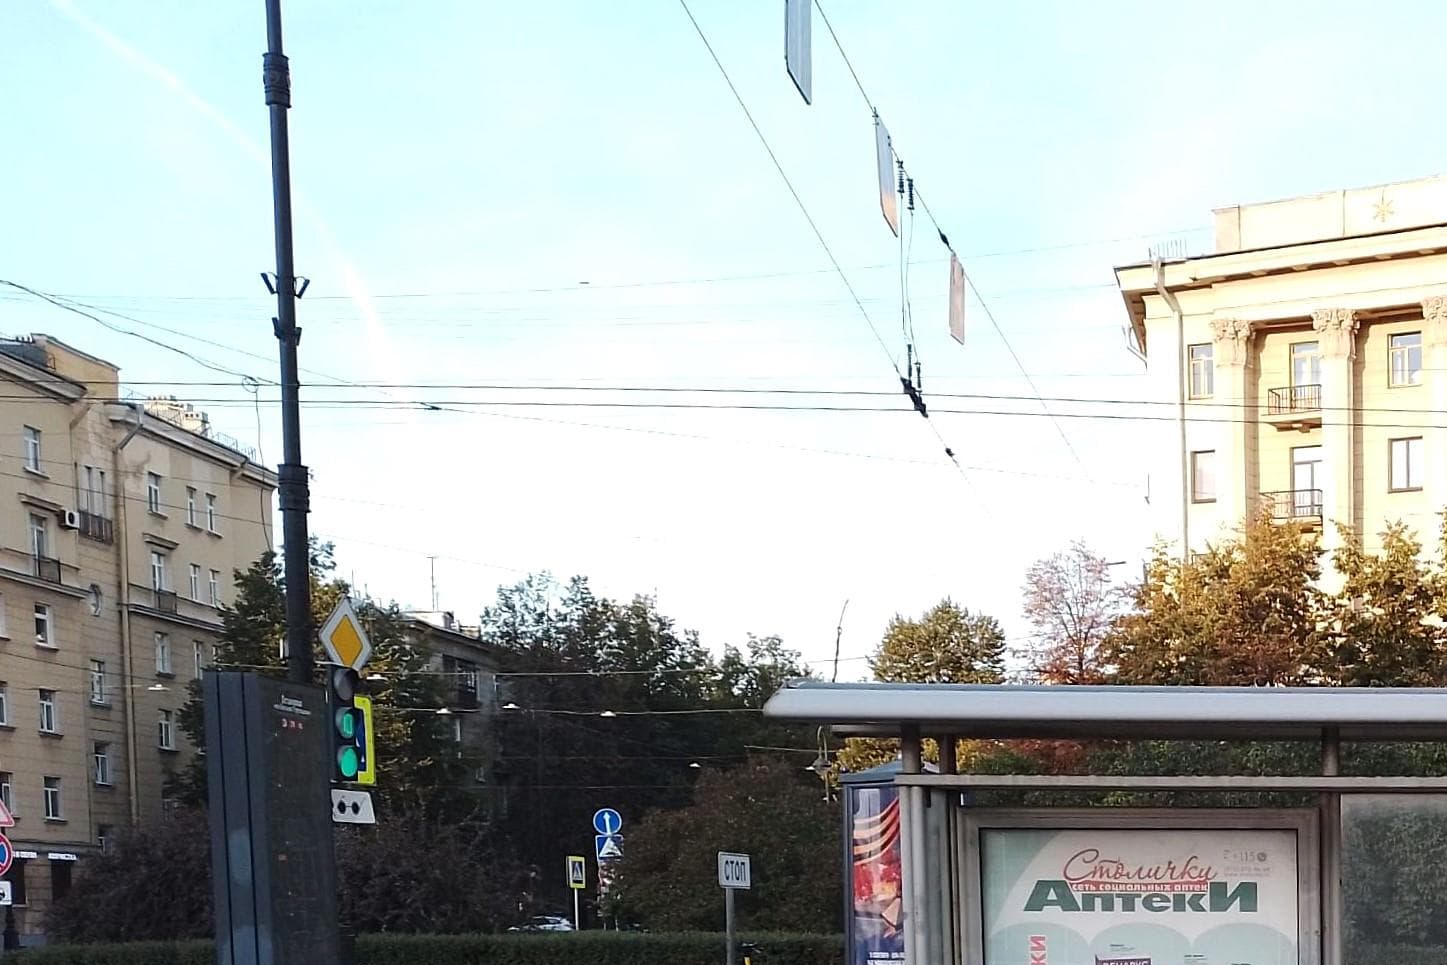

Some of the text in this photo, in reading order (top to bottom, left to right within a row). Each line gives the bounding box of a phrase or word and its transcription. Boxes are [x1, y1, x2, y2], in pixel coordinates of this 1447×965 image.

[724, 860, 747, 881] СТОП
[1063, 848, 1218, 881] Столички
[1072, 884, 1209, 893] сеть социальных аптек
